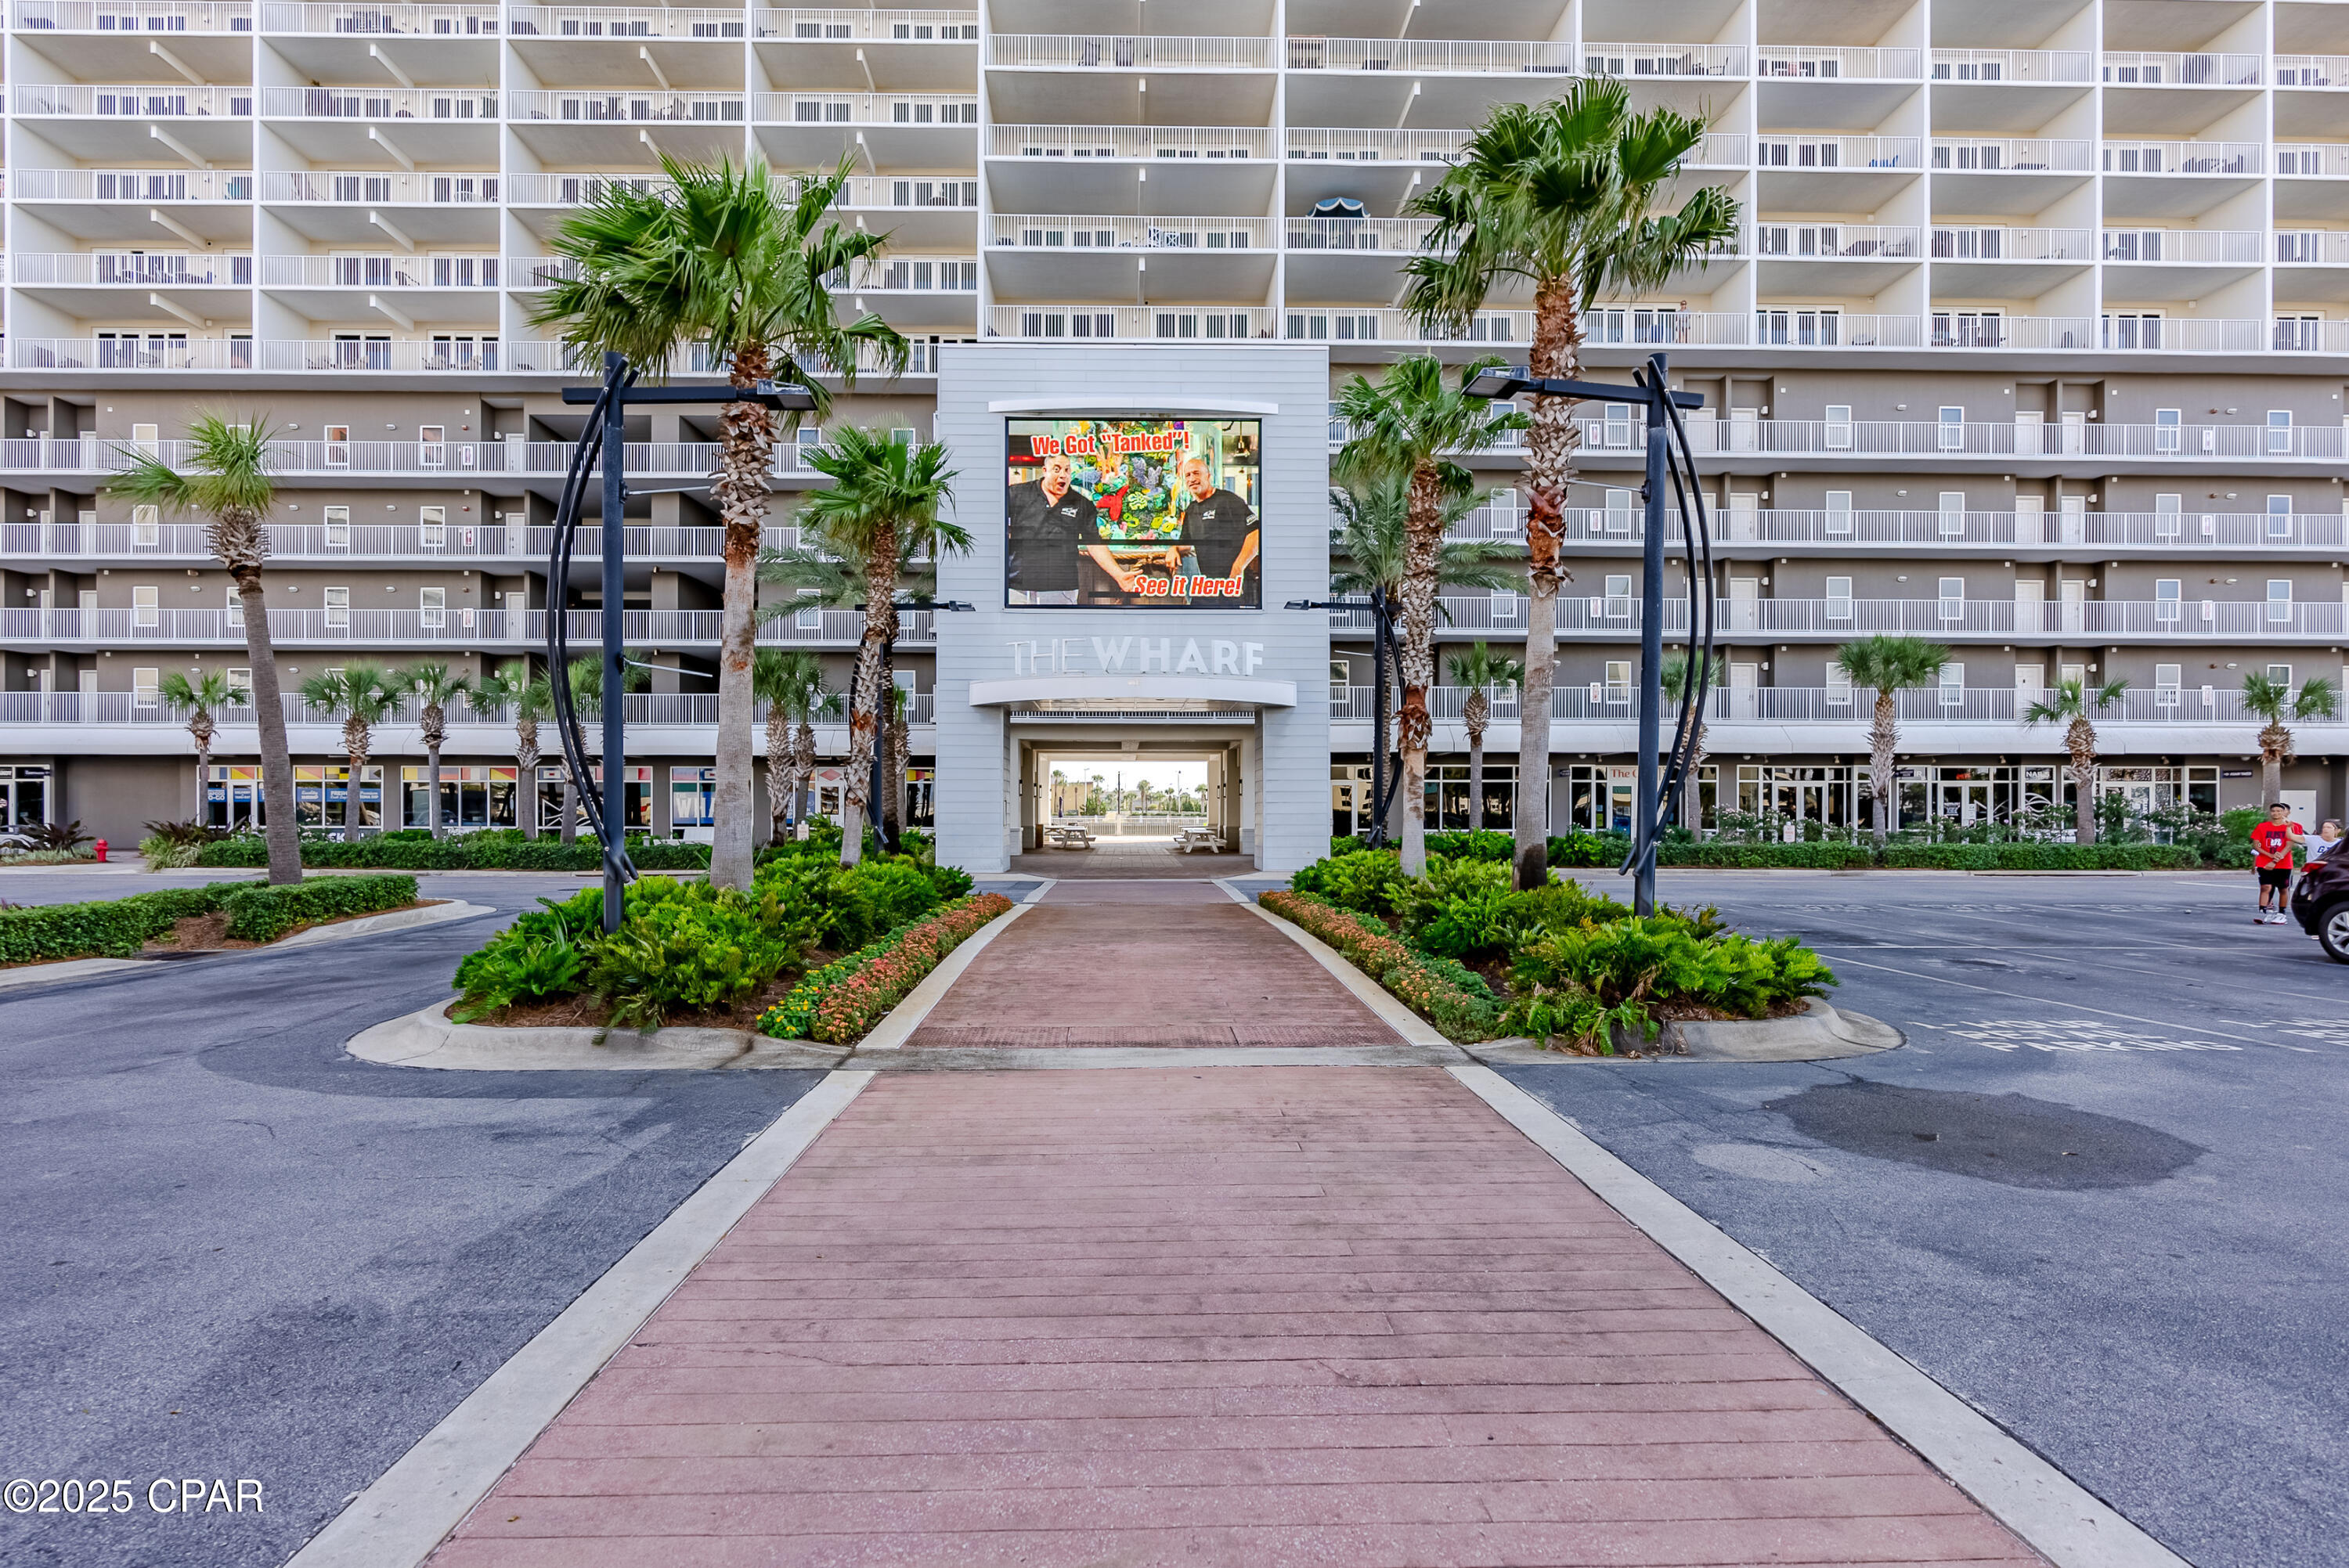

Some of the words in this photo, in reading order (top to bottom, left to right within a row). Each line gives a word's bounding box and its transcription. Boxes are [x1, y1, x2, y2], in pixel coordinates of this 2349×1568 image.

[1031, 435, 1060, 456] We
[1065, 434, 1095, 455] Got
[1101, 431, 1190, 452] "Tanked"!
[1135, 575, 1167, 595] See
[1172, 576, 1187, 595] it
[1190, 576, 1243, 595] Here!
[1006, 638, 1086, 676] THE
[1091, 636, 1264, 676] WHARF
[1611, 769, 1630, 778] The
[1947, 1030, 2167, 1040] RETAIL
[1975, 1040, 2243, 1052] PARKING
